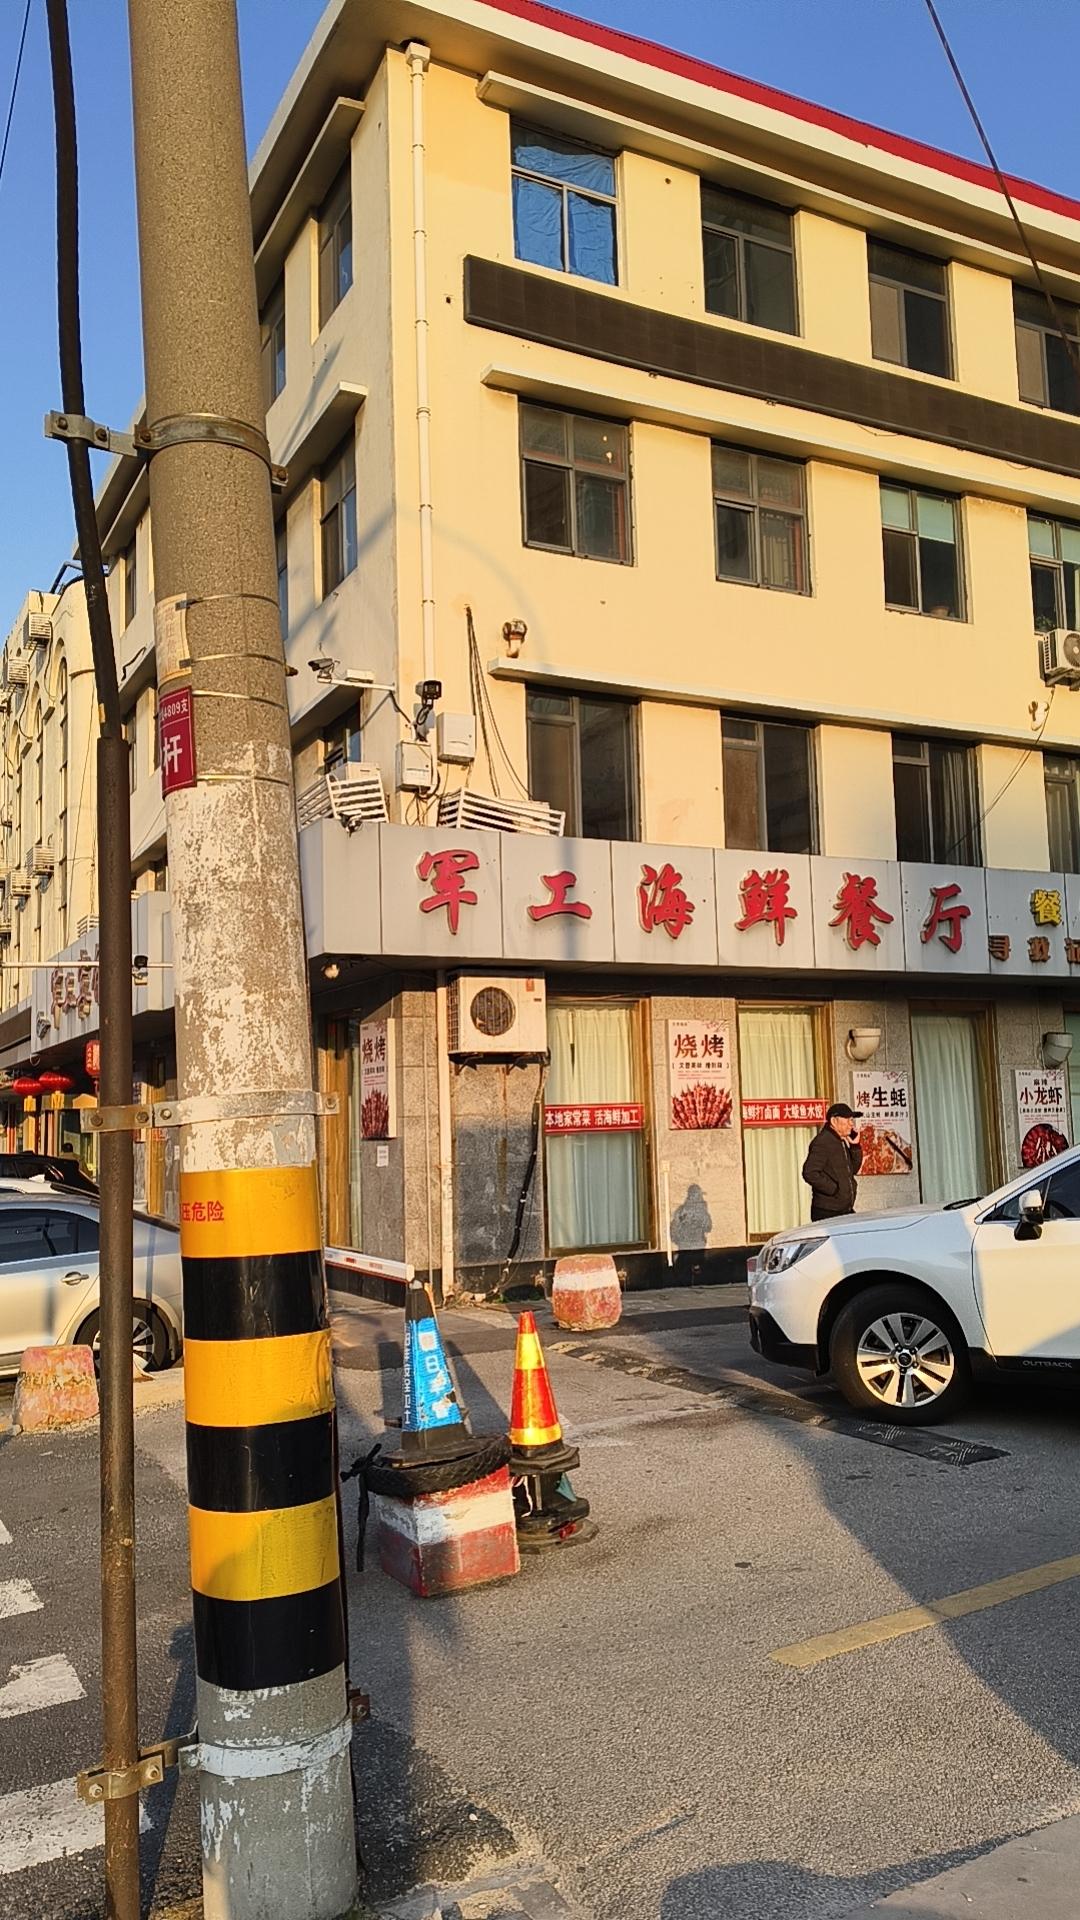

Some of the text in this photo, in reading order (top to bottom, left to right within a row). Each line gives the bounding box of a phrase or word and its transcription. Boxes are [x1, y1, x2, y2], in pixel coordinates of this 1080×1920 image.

[163, 734, 183, 776] 杆
[416, 848, 971, 953] 军工海鲜餐厅
[362, 1035, 386, 1065] 烧烤
[673, 1034, 725, 1059] 烧烤
[856, 1086, 907, 1108] 烤生蚝
[1020, 1086, 1063, 1105] 小龙虾
[545, 1107, 640, 1127] 本地家常菜 活海鲜加工
[783, 1103, 824, 1120] 大鲅鱼水饺
[1022, 1359, 1073, 1369] OUTBACK
